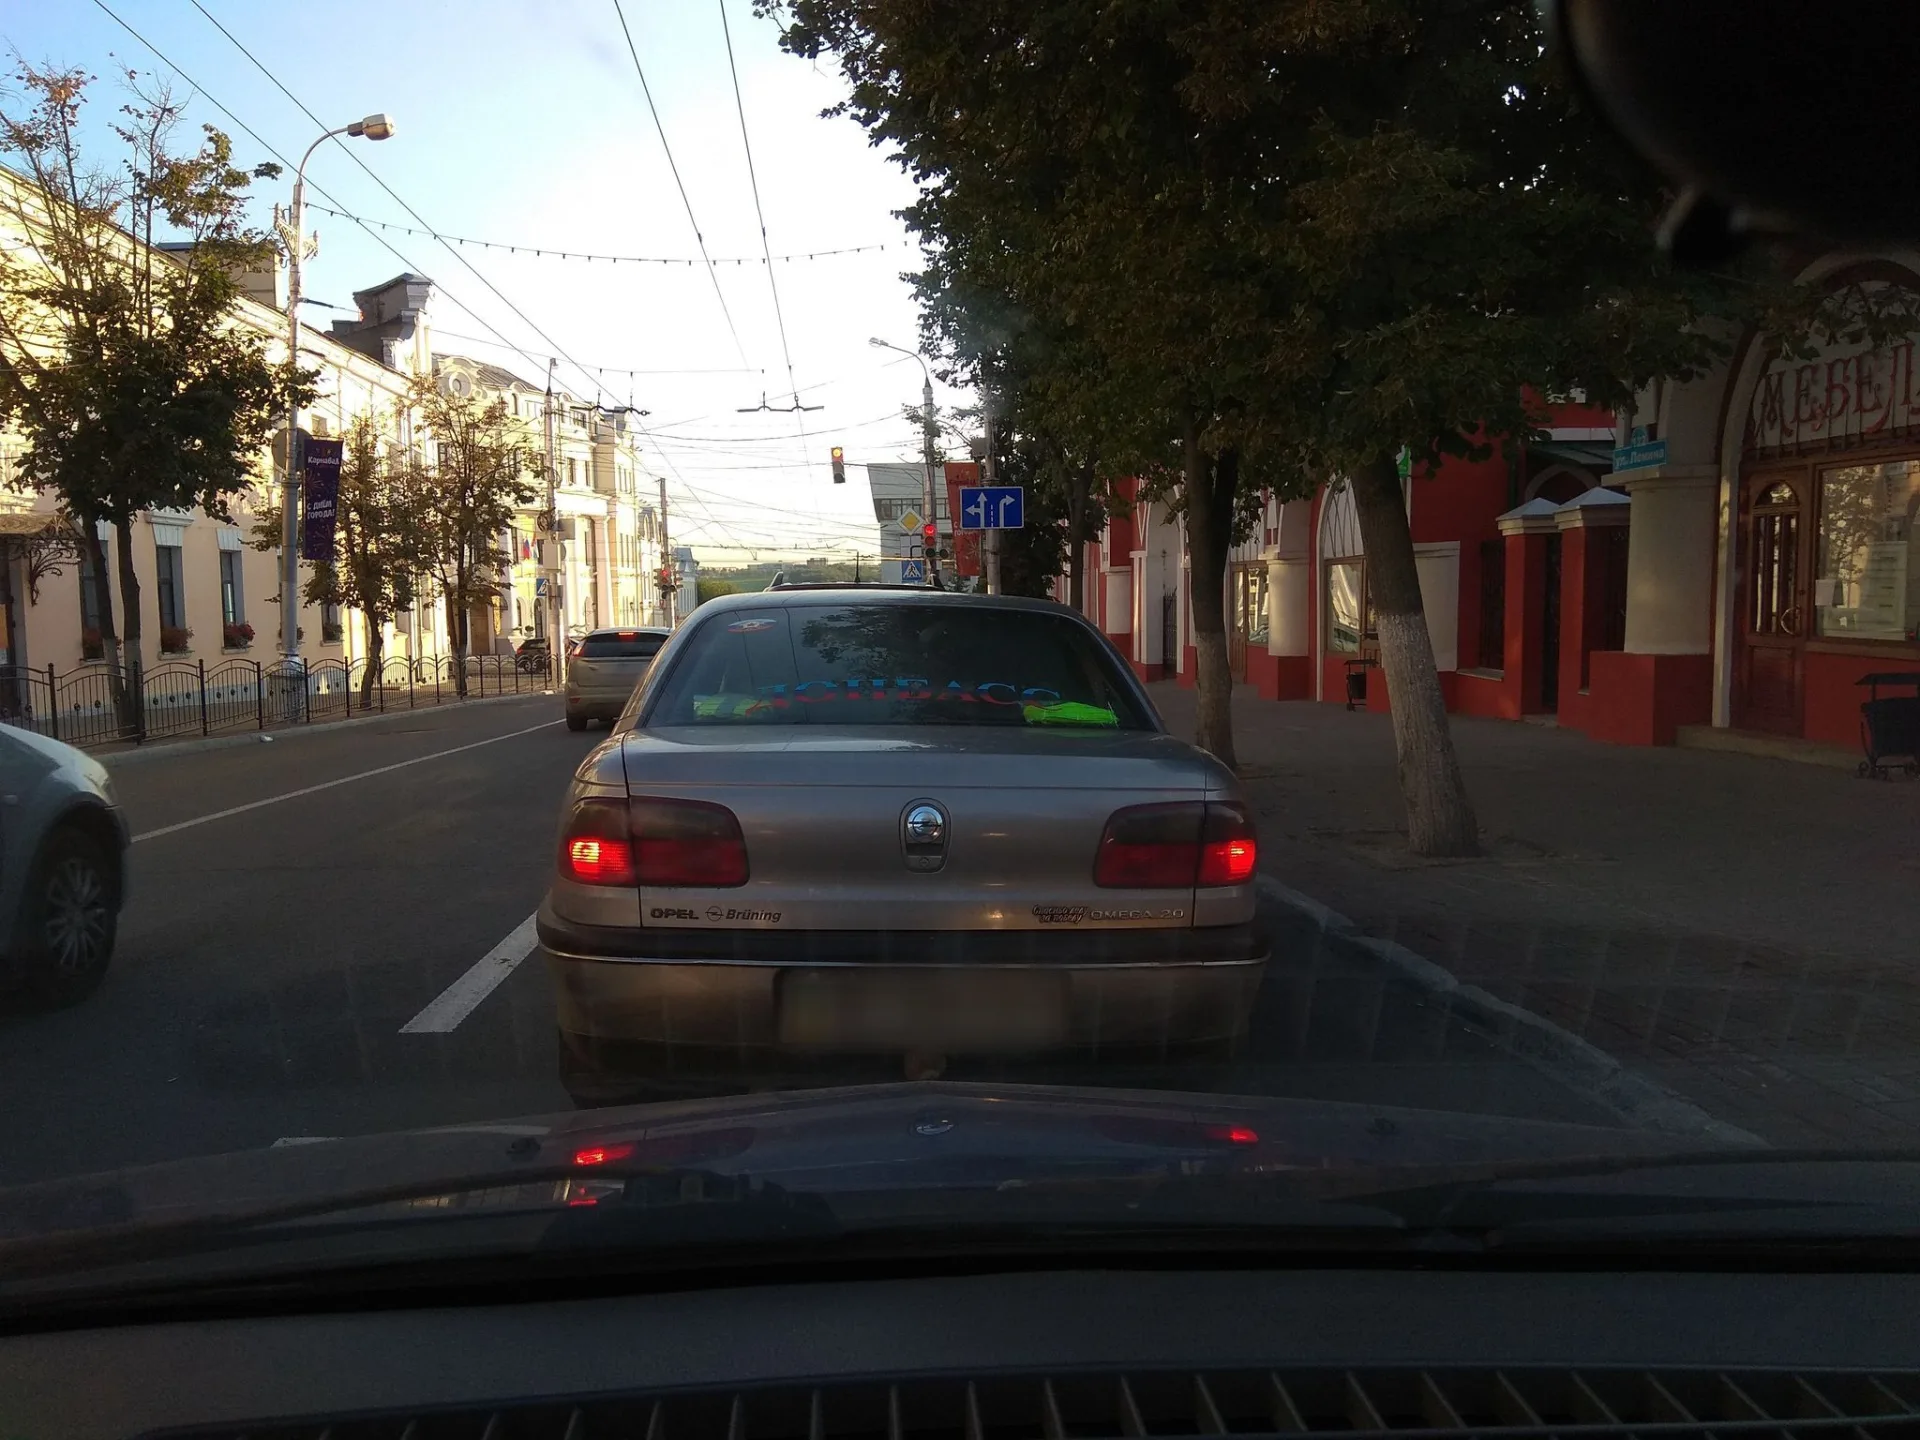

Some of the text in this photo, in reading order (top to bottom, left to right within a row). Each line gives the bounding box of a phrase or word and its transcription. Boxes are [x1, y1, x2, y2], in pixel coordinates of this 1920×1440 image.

[1752, 338, 1920, 440] МЕБЕЛ
[1630, 449, 1665, 464] Ленина
[307, 508, 335, 519] ГОРОДА!
[745, 677, 1063, 717] ДОНБАСС
[650, 908, 699, 920] OPEL
[726, 908, 782, 923] Brüning
[1091, 910, 1152, 920] OMEGA
